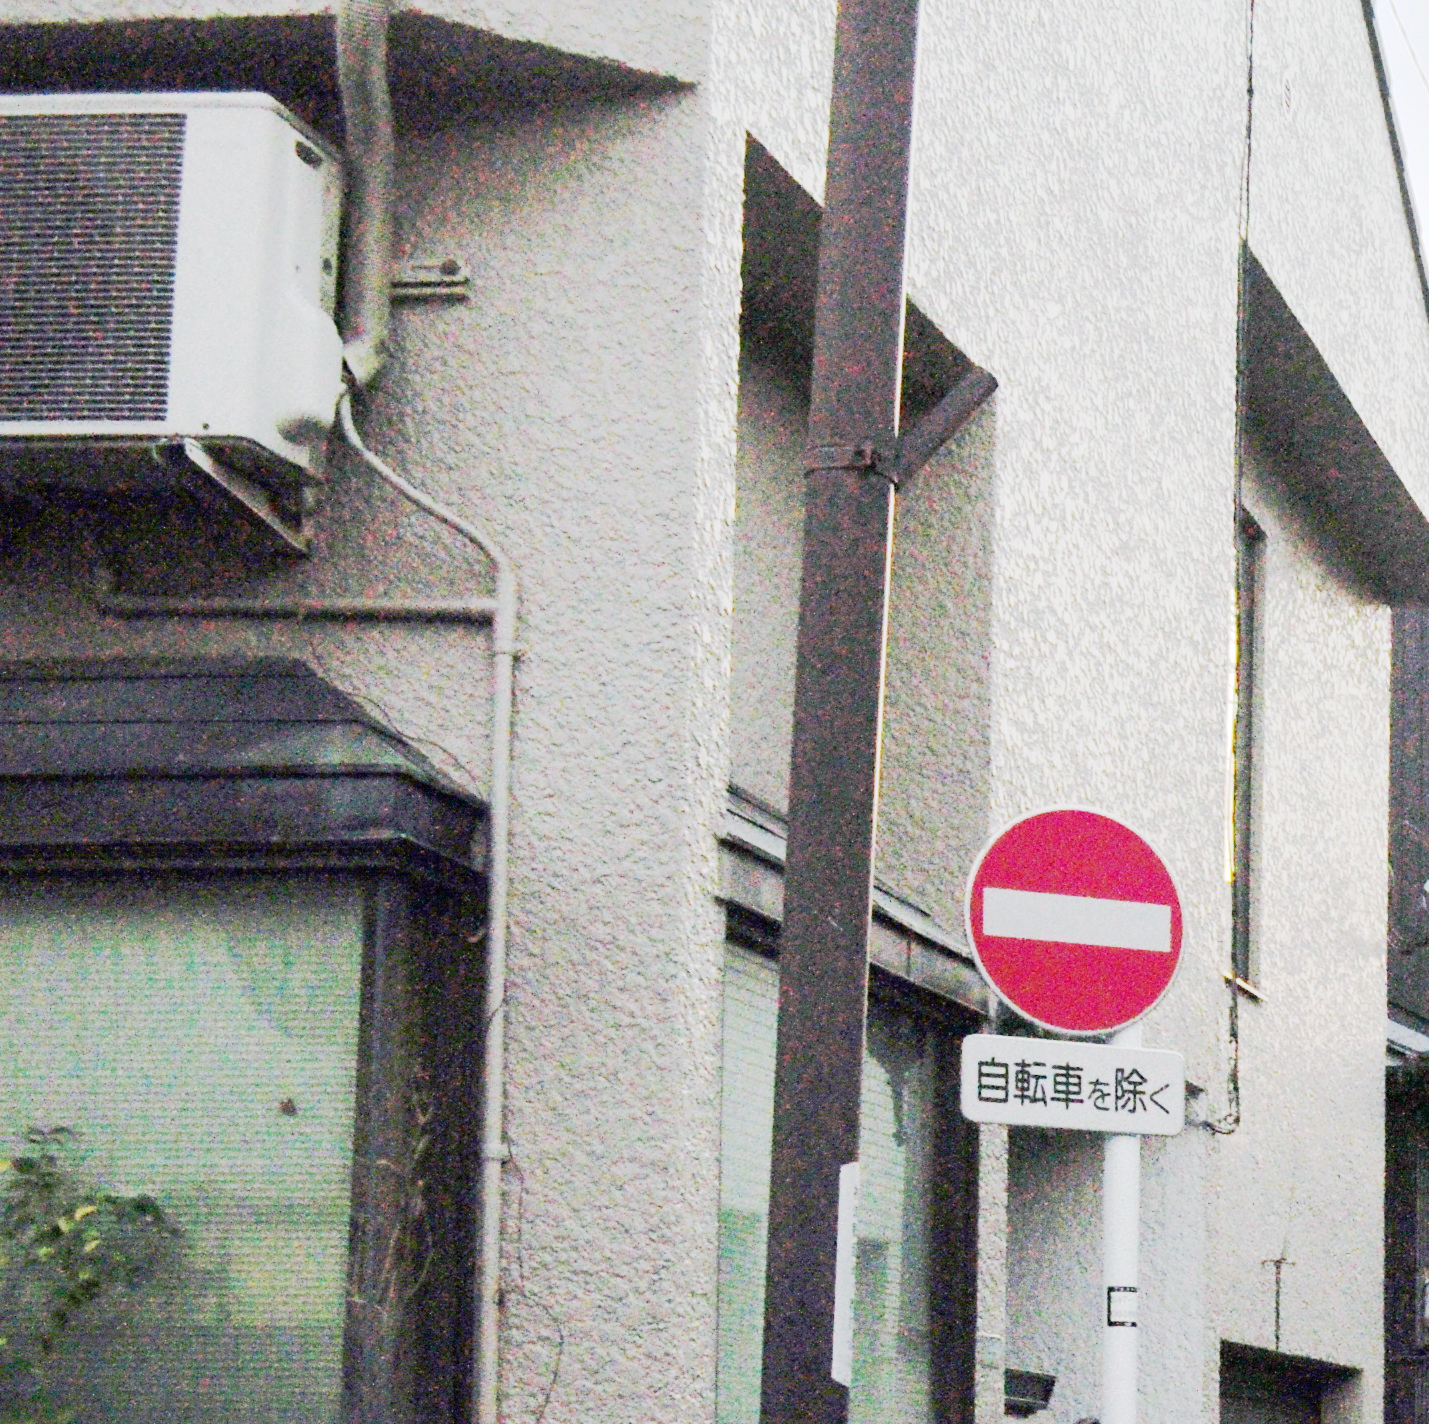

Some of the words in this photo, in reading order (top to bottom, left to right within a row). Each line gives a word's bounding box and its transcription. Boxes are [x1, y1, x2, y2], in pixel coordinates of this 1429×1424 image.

[976, 1057, 1171, 1115] 自転車を除く
